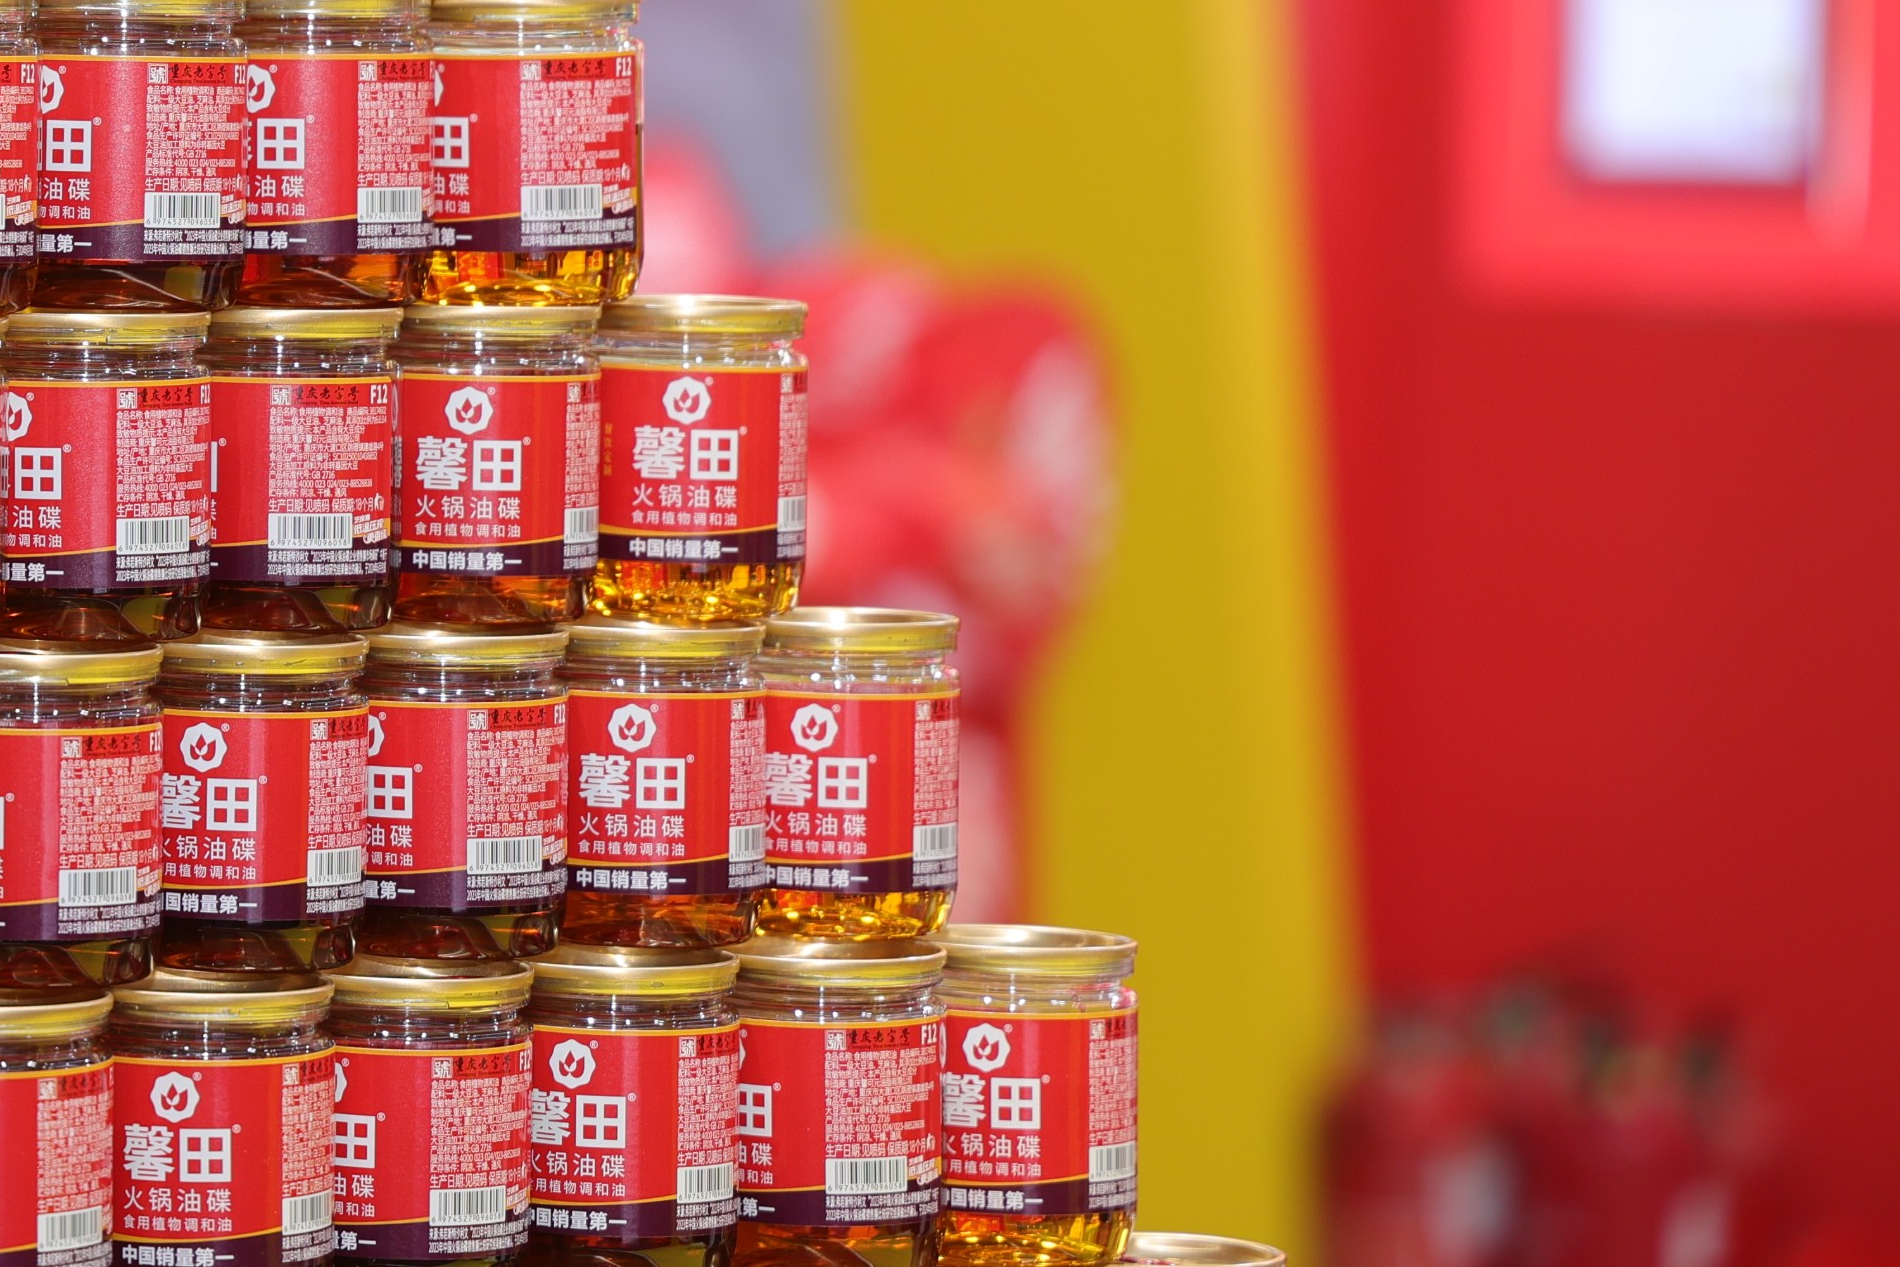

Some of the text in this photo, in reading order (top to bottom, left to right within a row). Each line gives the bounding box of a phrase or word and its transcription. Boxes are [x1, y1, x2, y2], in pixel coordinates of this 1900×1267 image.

[20, 63, 35, 83] F12
[234, 64, 245, 83] F12
[616, 59, 632, 78] F12
[201, 384, 210, 403] F12
[293, 386, 359, 401] 重庆老字号
[371, 384, 388, 403] F12
[416, 436, 521, 491] 馨田
[633, 426, 739, 480] 馨田
[633, 485, 737, 508] 火锅油碟
[415, 496, 520, 519] 火锅油碟
[632, 512, 737, 526] 食用植物调和油
[415, 523, 520, 538] 食用植物调和油
[629, 537, 738, 559] 中国销量第一
[412, 550, 522, 570] 中国销量第一
[554, 704, 566, 724] F12
[579, 753, 686, 809] 馨田
[765, 751, 868, 808] 馨田
[579, 814, 685, 838] 火锅油碟
[765, 811, 867, 837] 火锅油碟
[578, 840, 685, 856] 食用植物调和油
[577, 868, 686, 889] 中国销量第一
[921, 1024, 937, 1044] F12
[520, 1051, 531, 1071] F12
[531, 1088, 626, 1148] 馨田
[124, 1124, 231, 1182] 馨田
[124, 1186, 231, 1213] 火锅油碟
[123, 1214, 232, 1232] 食用植物调和油
[122, 1245, 234, 1267] 中国销量第一
